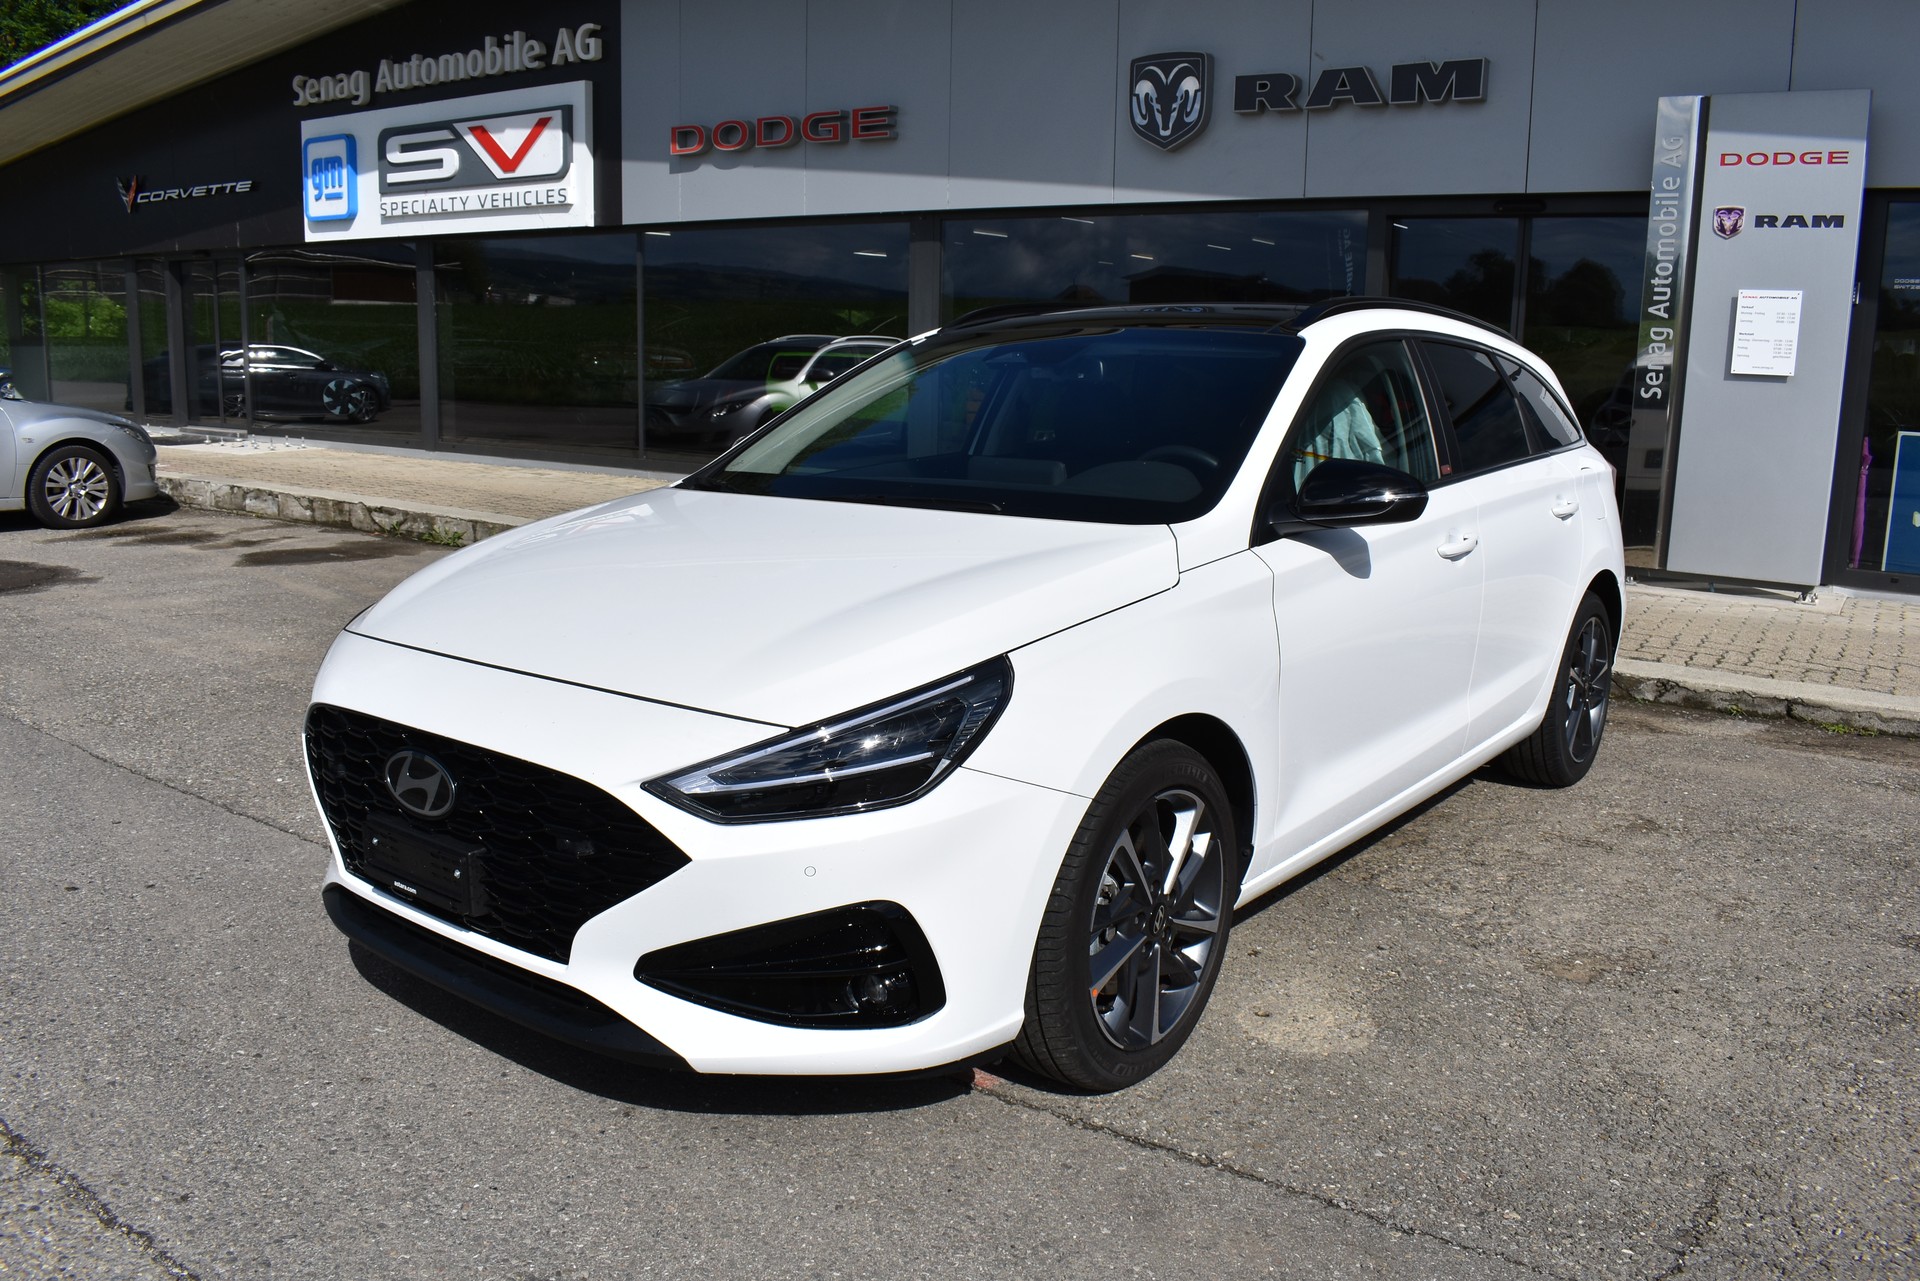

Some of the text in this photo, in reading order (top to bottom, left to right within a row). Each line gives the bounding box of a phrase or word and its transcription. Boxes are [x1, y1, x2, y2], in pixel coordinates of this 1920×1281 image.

[291, 22, 602, 106] Senag Automobile AG
[1233, 56, 1490, 116] RAM
[669, 104, 898, 157] DODGE
[310, 153, 344, 202] gm
[1719, 150, 1850, 167] DODGE
[136, 180, 253, 203] CORVETTE
[380, 187, 568, 217] SPECIALTY VEHICLES
[1754, 214, 1845, 229] RAM
[1640, 136, 1684, 400] Senag Automobile AG
